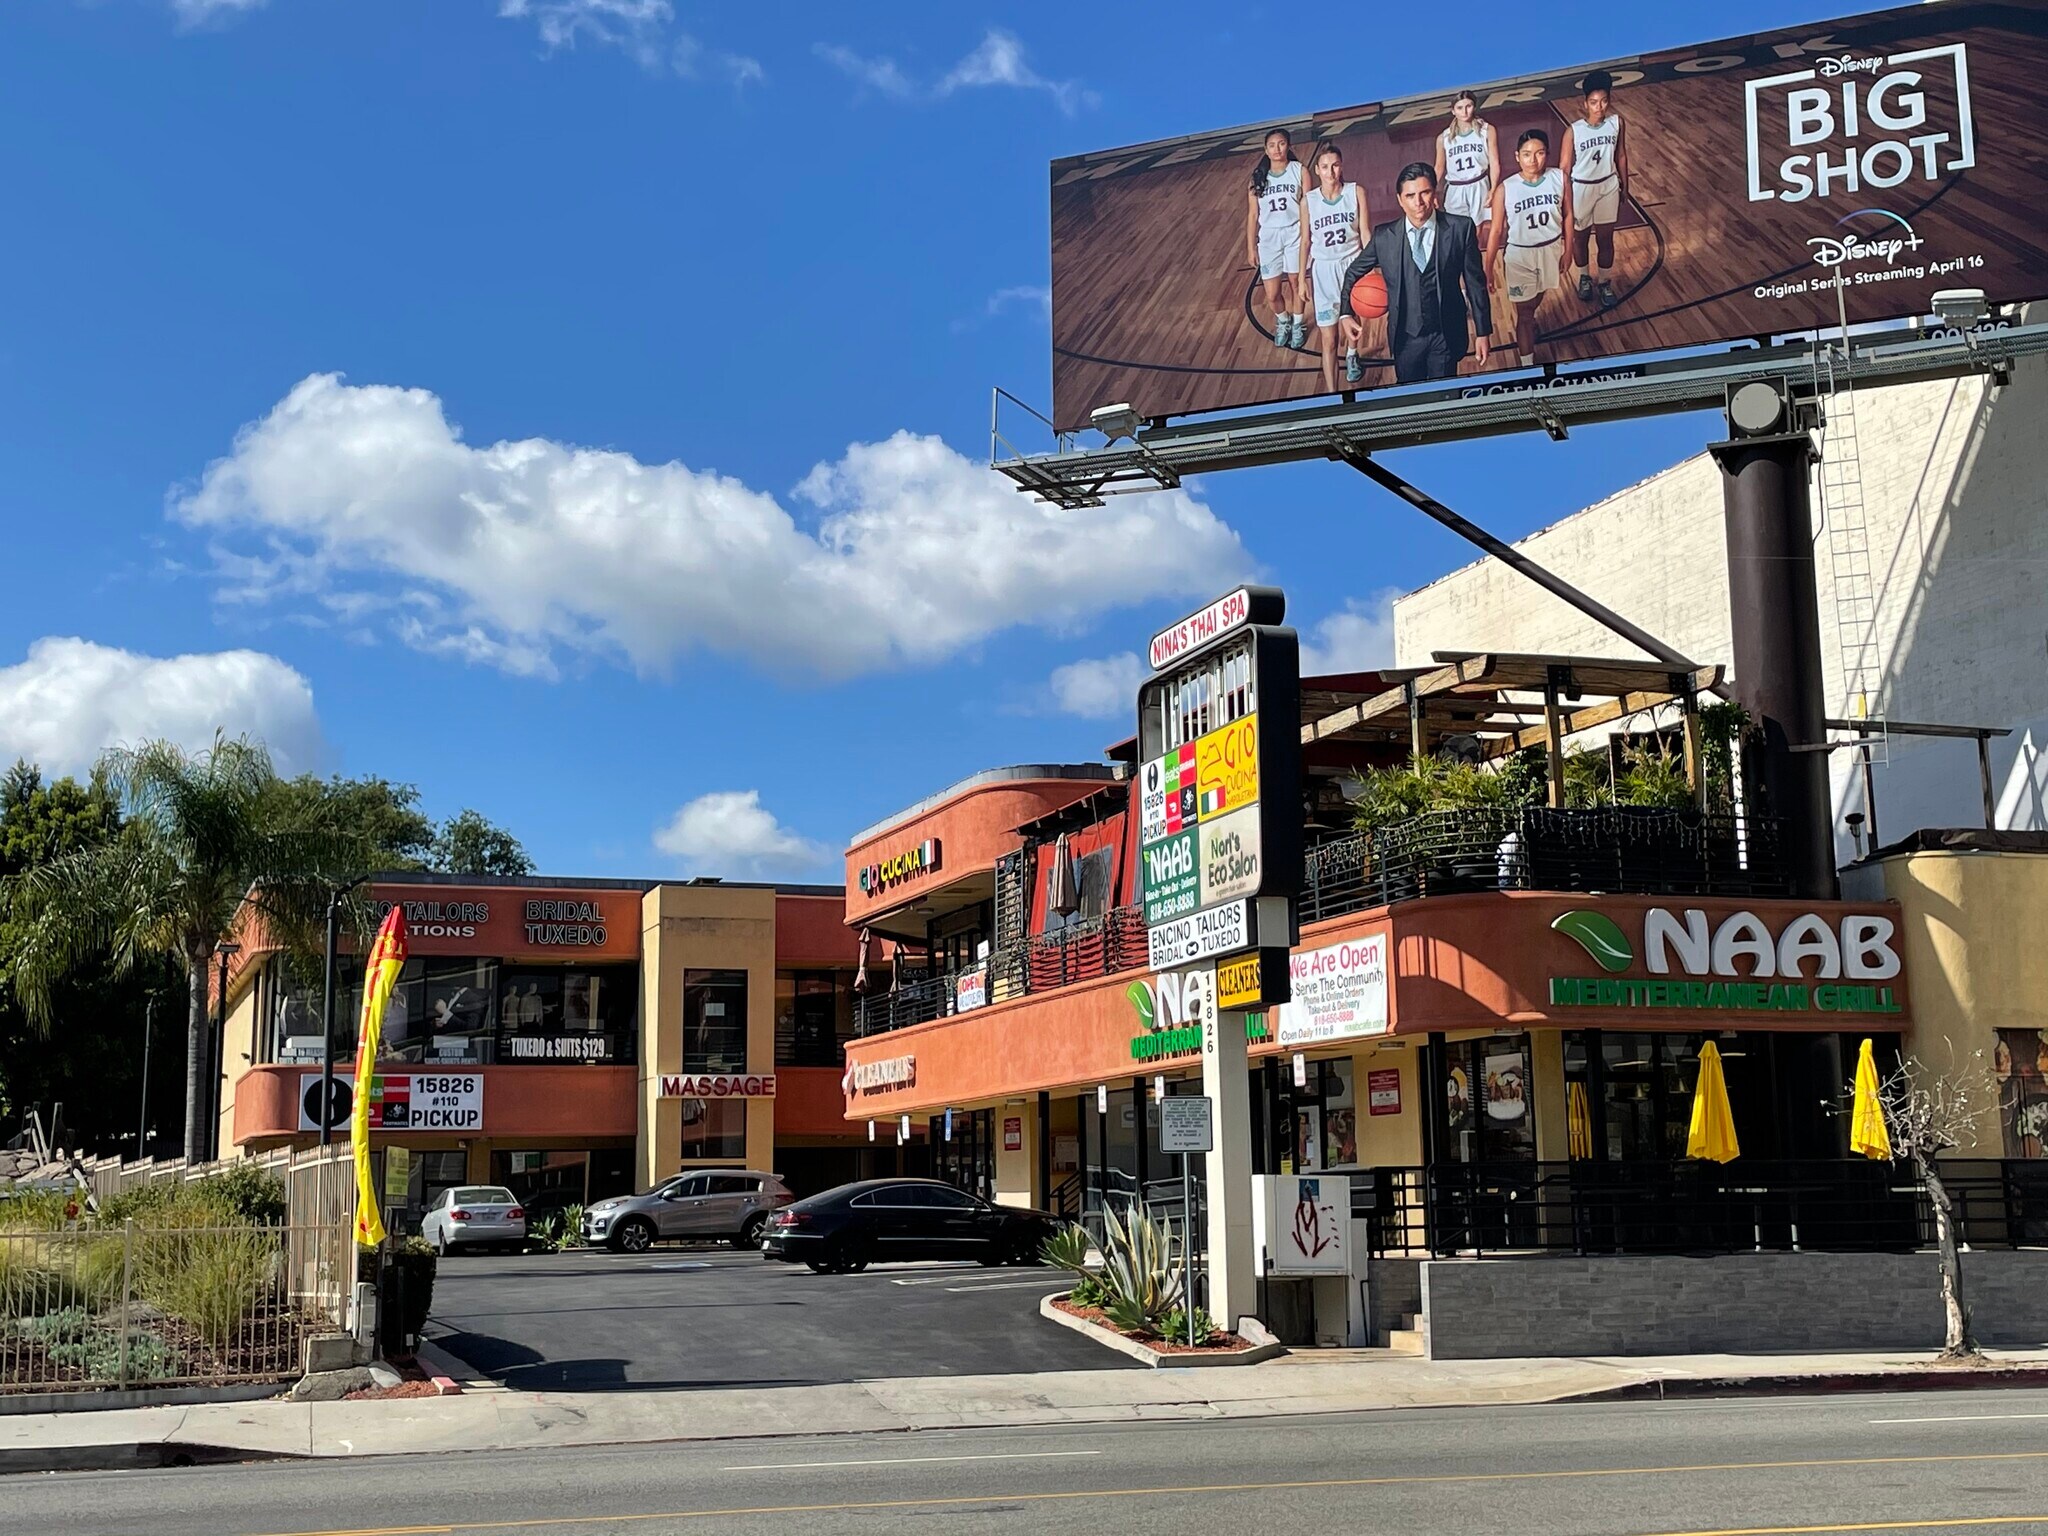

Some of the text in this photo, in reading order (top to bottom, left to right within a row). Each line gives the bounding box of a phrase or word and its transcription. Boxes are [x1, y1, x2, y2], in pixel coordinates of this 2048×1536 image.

[1787, 71, 1926, 147] BIG
[1448, 143, 1483, 157] SIRENS
[1579, 134, 1617, 151] SIRENS
[1455, 156, 1476, 172] 11
[1592, 149, 1602, 165] 4
[1778, 133, 1949, 202] SHOT
[1268, 197, 1288, 212] 13
[1514, 193, 1560, 214] SIRENS
[1314, 212, 1355, 230] SIRENS
[1526, 210, 1550, 230] 10
[1324, 227, 1347, 248] 23
[1754, 279, 1807, 299] Original
[1855, 265, 1925, 284] Streaming
[1929, 257, 1964, 275] April
[1968, 255, 1984, 268] 16
[1153, 594, 1245, 664] NINA'S THAI SPA
[1225, 723, 1255, 768] GIO
[1226, 762, 1257, 795] CUCINA
[1144, 790, 1164, 811] 15826
[1144, 820, 1166, 841] PICKUP
[1211, 832, 1241, 860] Nori's
[859, 848, 920, 892] GIO CUCINA
[1150, 835, 1193, 885] NAAB
[1208, 851, 1258, 888] Eco Salon
[403, 901, 489, 922] TAILORS
[526, 900, 606, 922] BRIDAL
[525, 924, 608, 945] TUXEDO
[1152, 903, 1241, 949] ENCINO TAILORS
[1153, 927, 1241, 966] BRIDAL TUXEDO
[1645, 908, 1901, 980] NAAB
[1290, 945, 1378, 979] We Are Open
[1218, 962, 1261, 998] CLEANERS
[1296, 982, 1318, 997] Serve
[1319, 978, 1335, 992] The
[1337, 967, 1384, 988] Community
[1156, 970, 1202, 1027] NA
[1303, 995, 1320, 1006] Phone
[1345, 988, 1364, 998] Orders
[1337, 1000, 1360, 1011] Delivery
[1550, 978, 1902, 1013] MEDITERRANEAN GRILL
[1131, 1026, 1203, 1059] MEDITERRAN
[1281, 1030, 1297, 1041] Open
[1298, 1028, 1313, 1040] Daily
[510, 1037, 605, 1059] TUXEDO & SUITS $129
[417, 1078, 474, 1093] 15826
[661, 1077, 775, 1096] MASSAGE
[432, 1096, 459, 1106] #110
[411, 1110, 478, 1126] PICKUP
